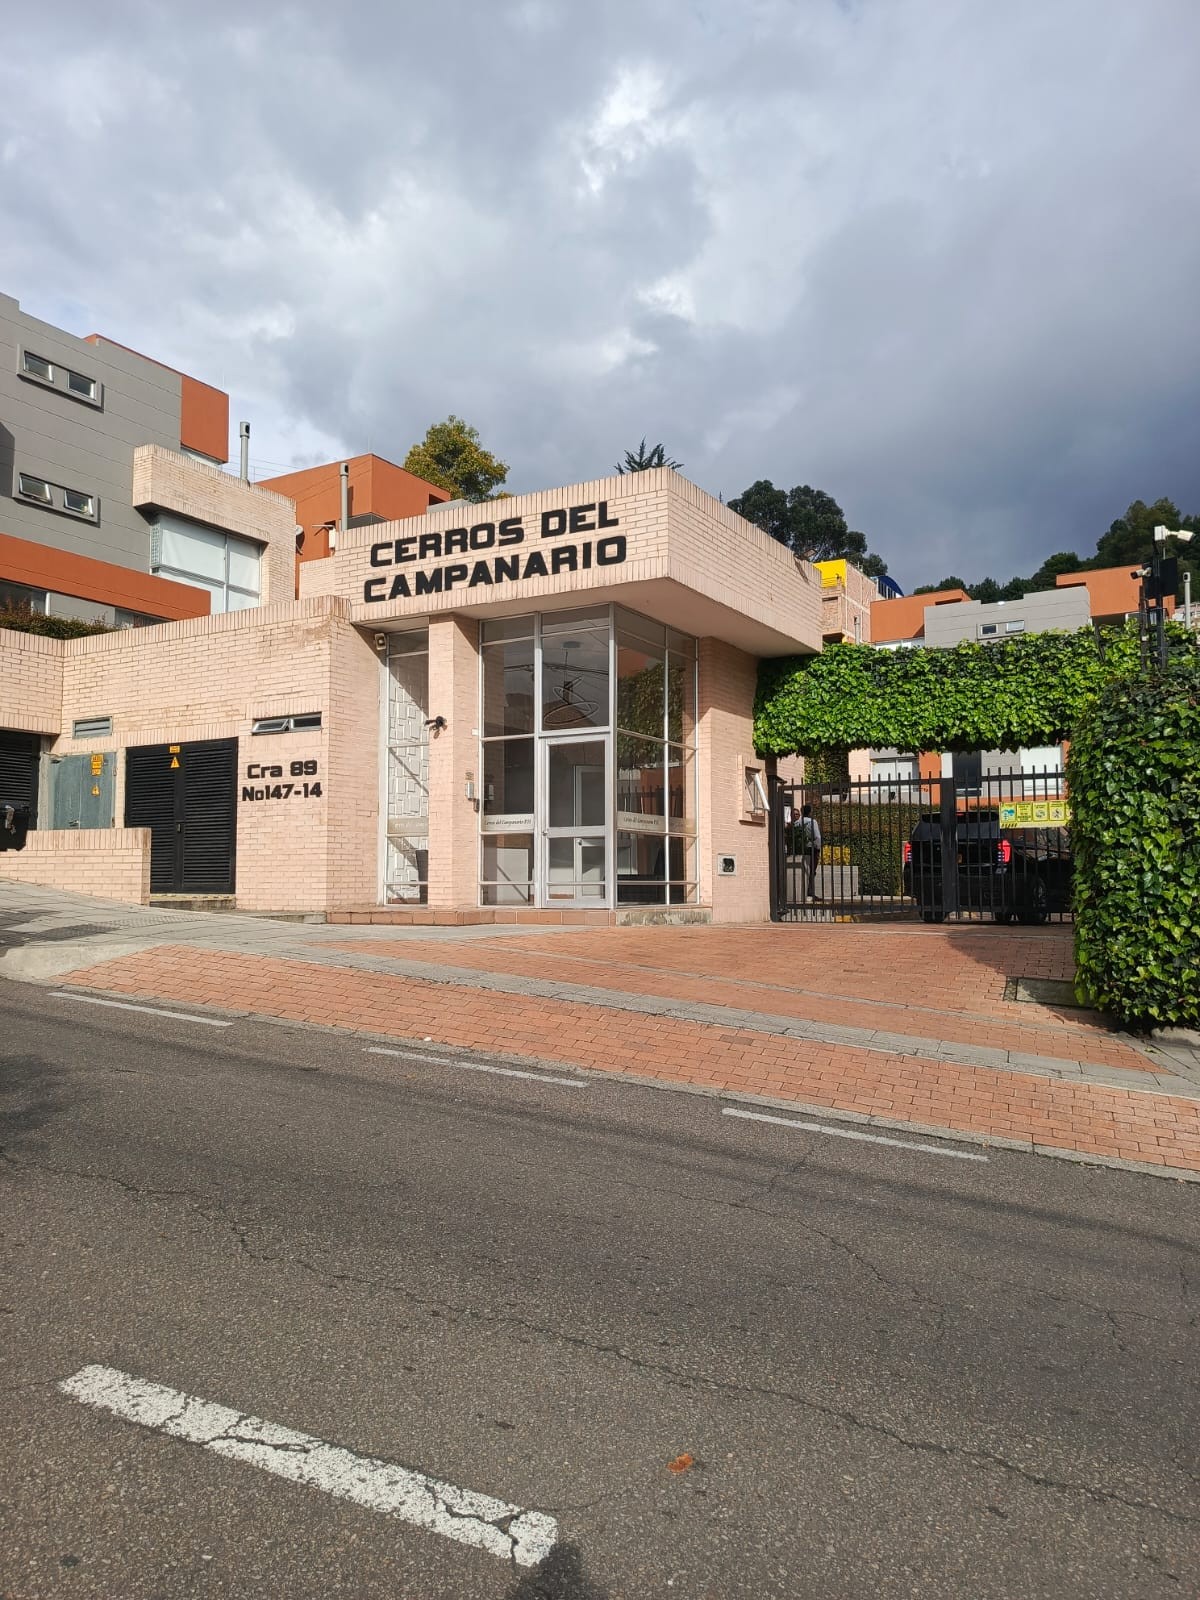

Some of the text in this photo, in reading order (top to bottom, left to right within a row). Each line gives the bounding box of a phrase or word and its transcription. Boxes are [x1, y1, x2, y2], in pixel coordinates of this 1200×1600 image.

[370, 501, 619, 568] CERROS DEL
[364, 535, 627, 603] CAMPANARIO
[247, 760, 318, 779] Cra 89
